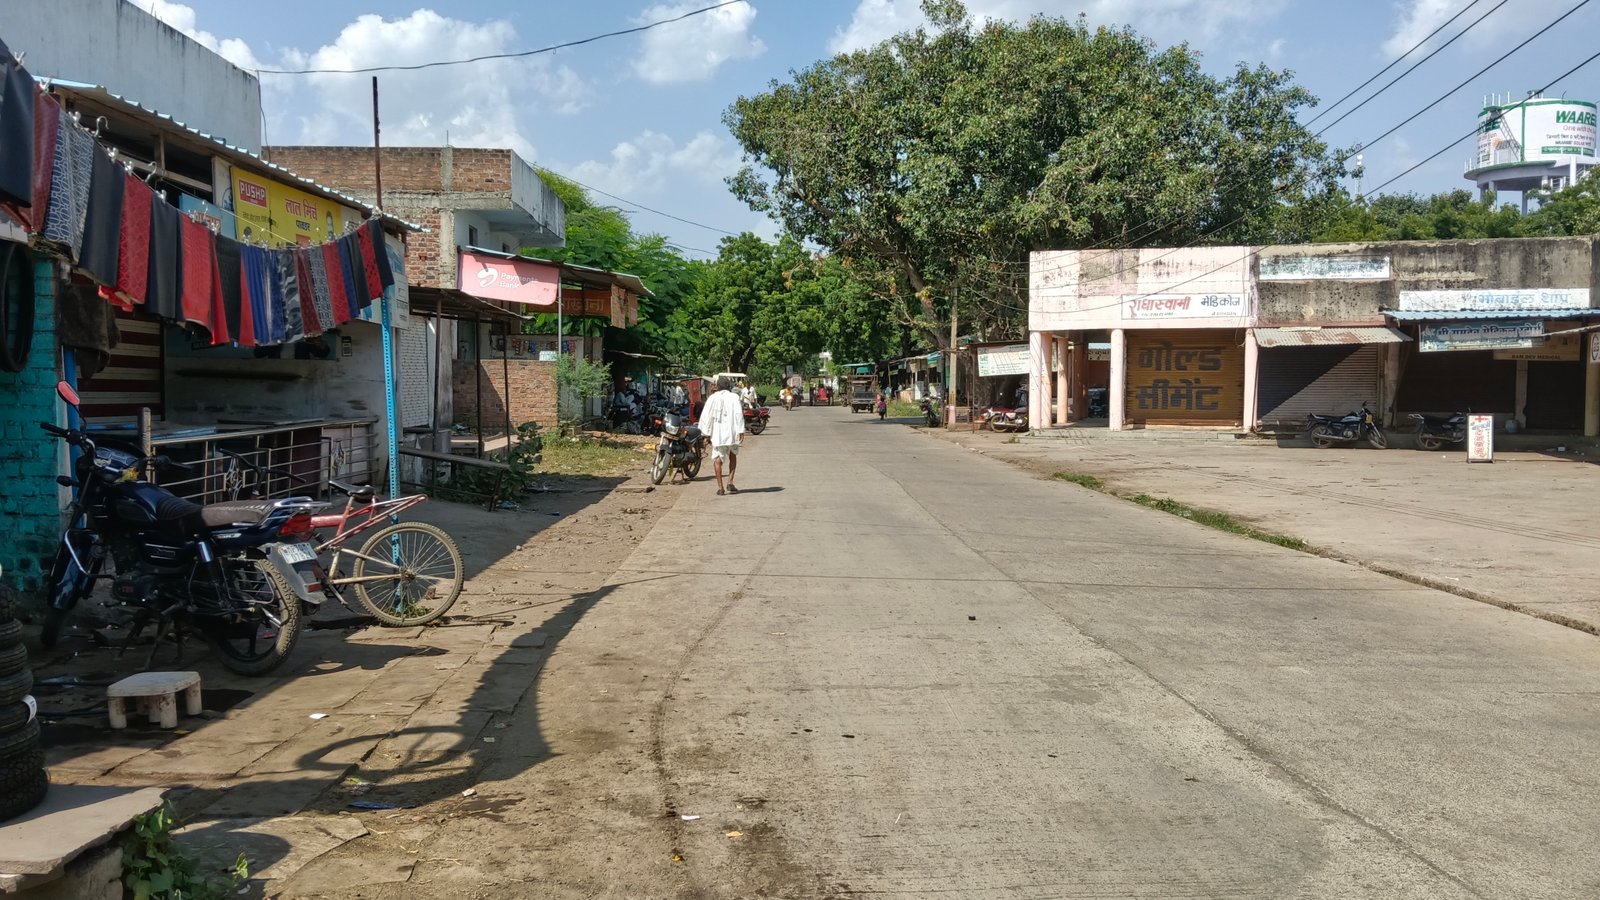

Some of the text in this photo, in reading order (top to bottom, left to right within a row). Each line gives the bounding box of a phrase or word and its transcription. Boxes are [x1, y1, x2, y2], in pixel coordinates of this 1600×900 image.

[240, 182, 266, 200] PUSHP
[284, 198, 301, 216] लाल
[499, 281, 519, 289] Bank
[500, 271, 539, 284] Payments
[1129, 294, 1241, 318] राधास्वामी मेडिकोज
[1138, 341, 1226, 371] गोल्ड
[1135, 378, 1223, 410] सीमेंट
